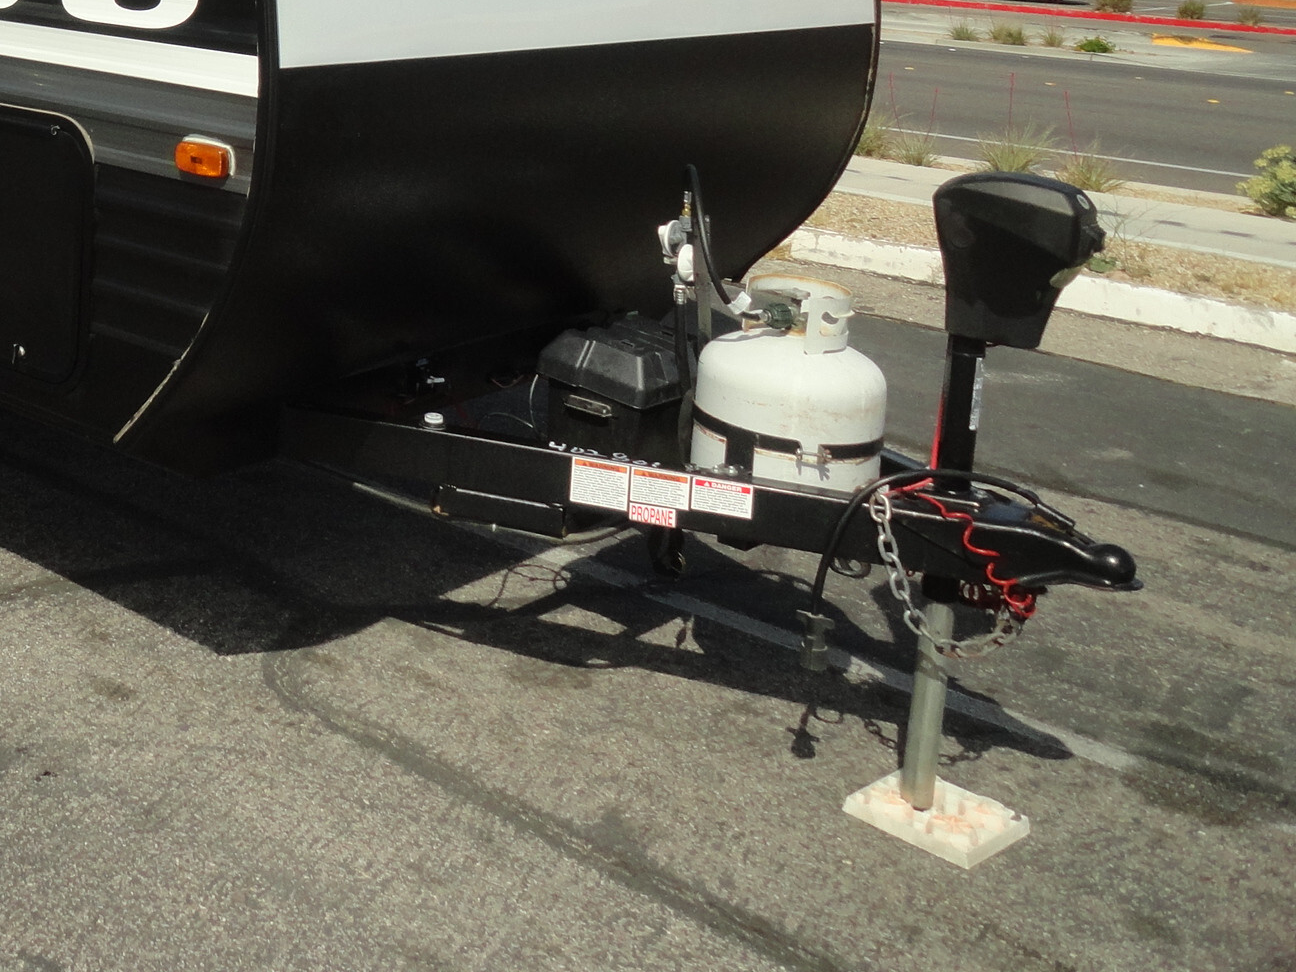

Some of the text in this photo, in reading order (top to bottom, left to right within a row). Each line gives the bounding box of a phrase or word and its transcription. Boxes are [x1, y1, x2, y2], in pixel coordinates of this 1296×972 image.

[589, 461, 620, 473] WARNING
[647, 471, 680, 483] WARNING
[711, 481, 742, 493] DANGER
[631, 505, 674, 527] PROPANE
